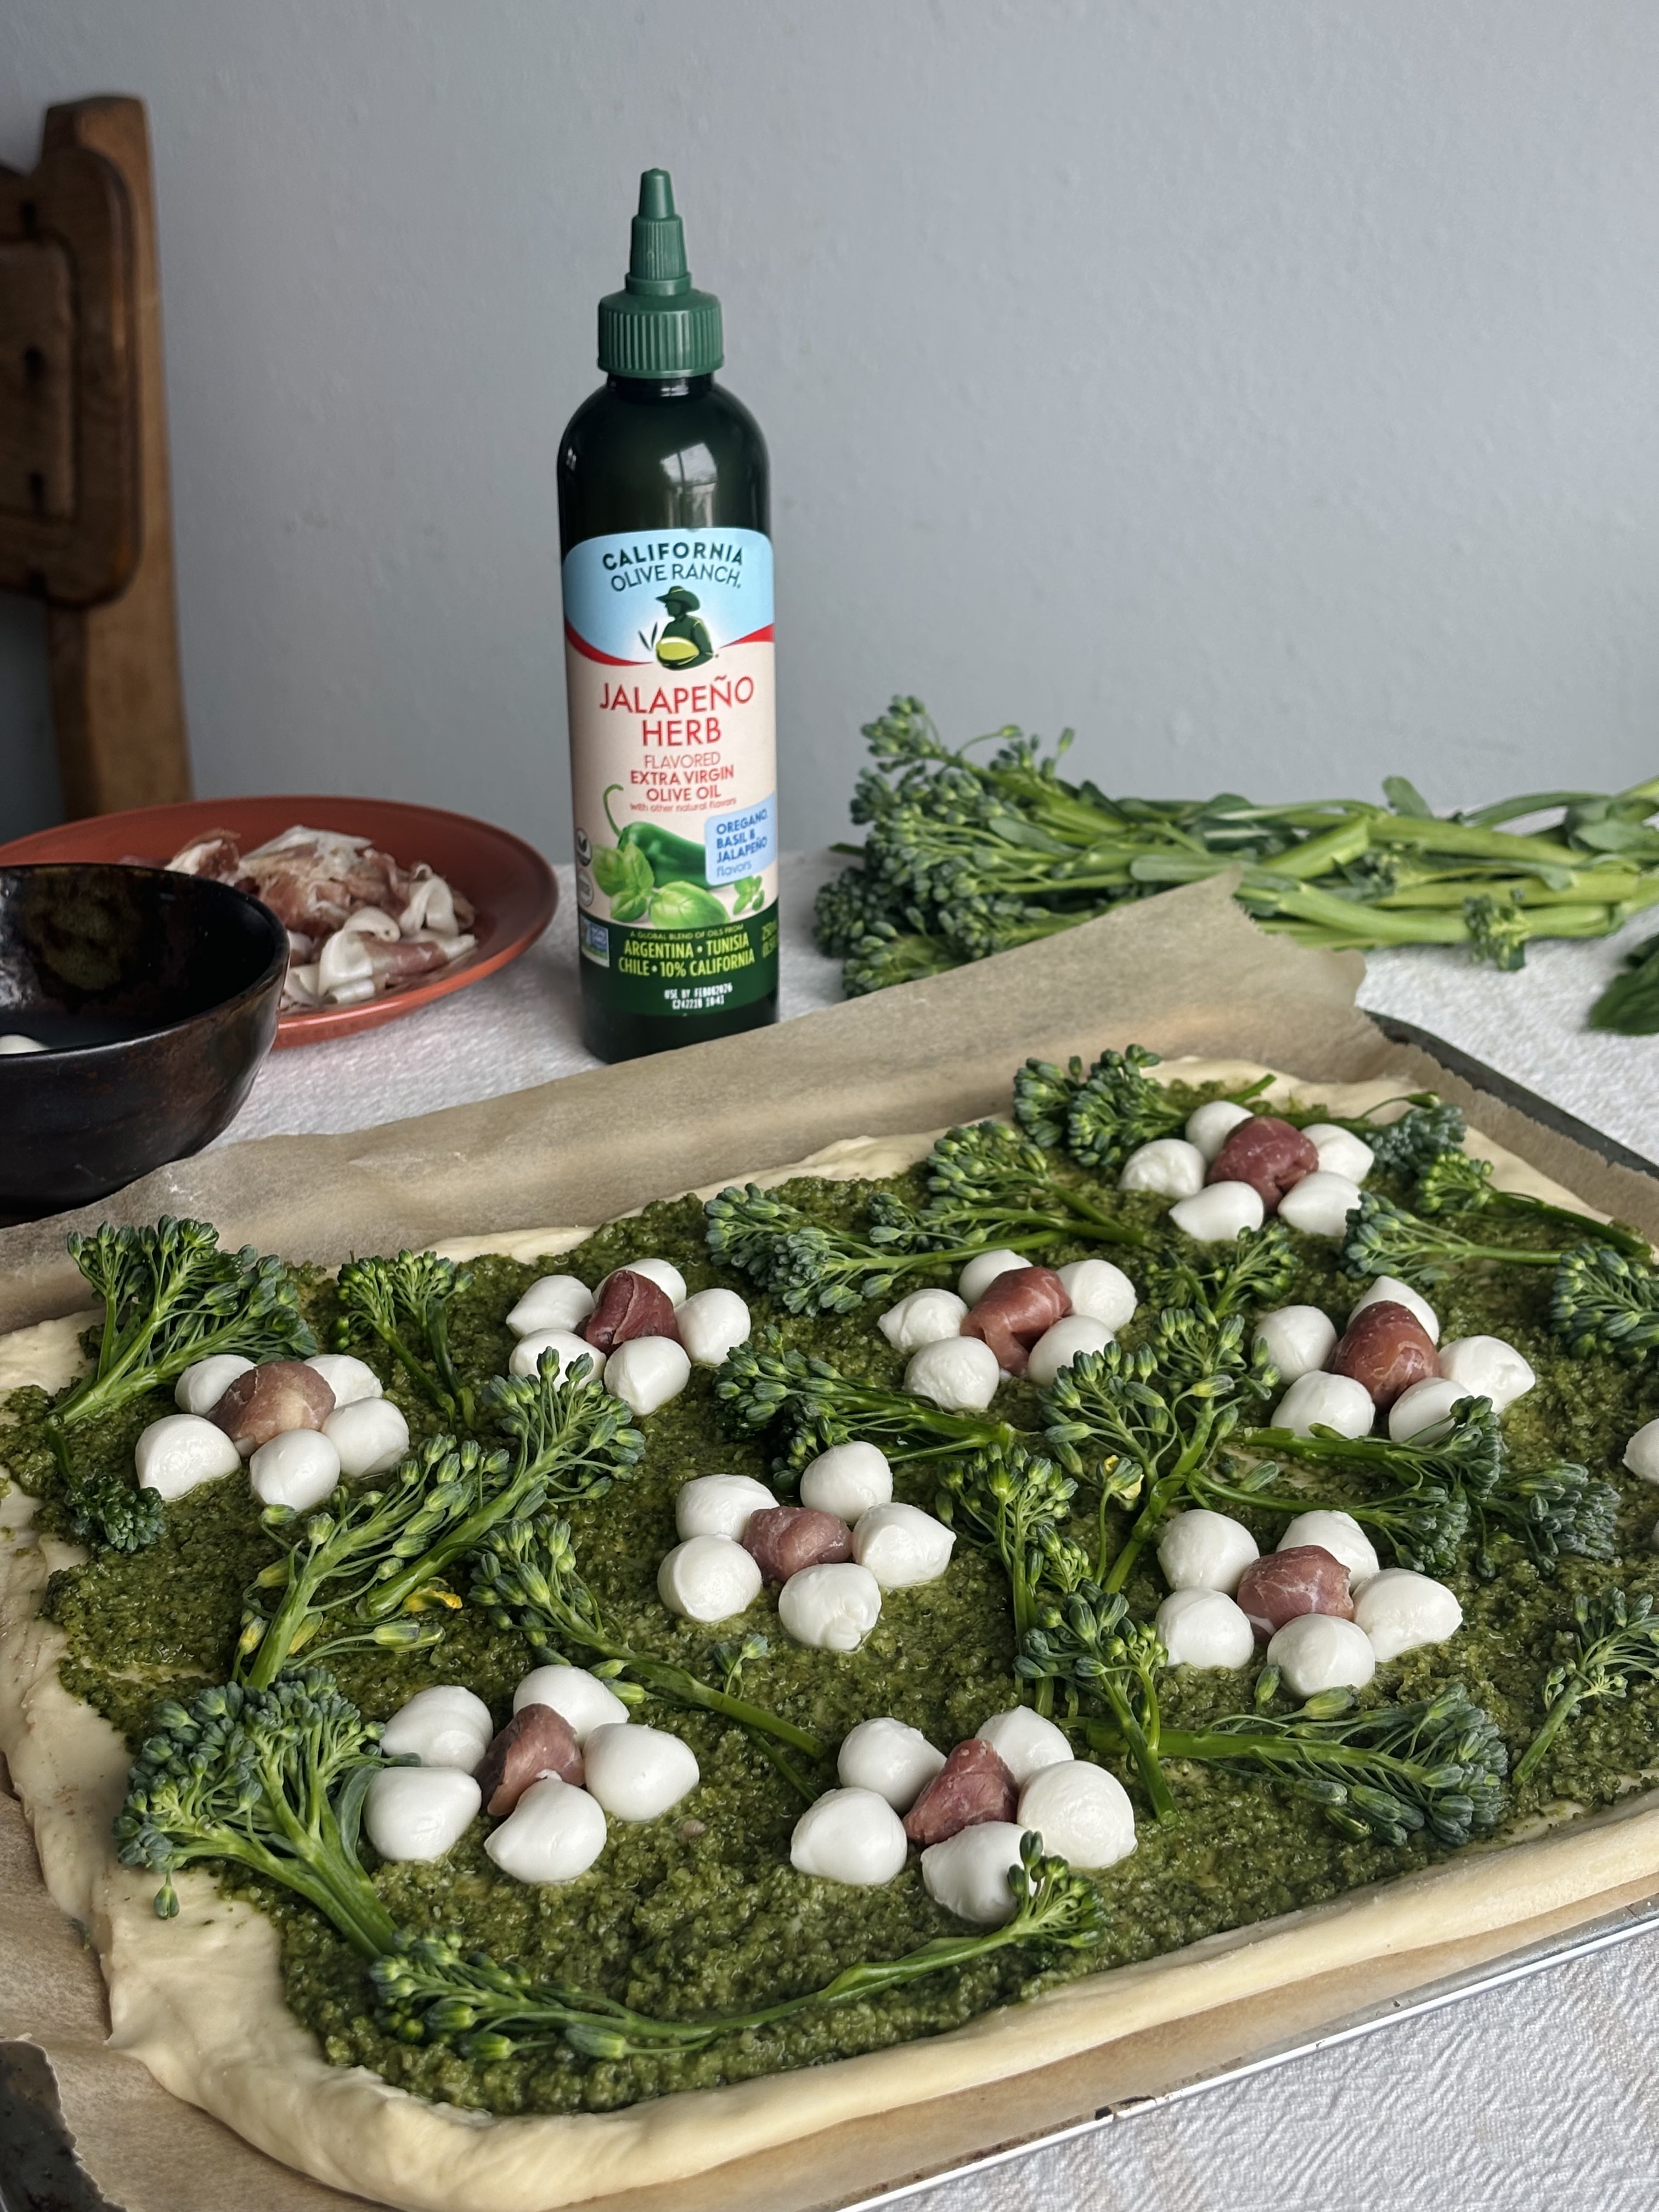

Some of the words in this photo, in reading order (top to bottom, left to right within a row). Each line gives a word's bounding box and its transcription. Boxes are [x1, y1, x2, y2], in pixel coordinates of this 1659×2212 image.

[602, 542, 742, 571] CALIFORNIA
[611, 565, 668, 592] OLIVE
[600, 675, 754, 714] JALAPEÑO
[642, 717, 721, 747] HERB
[644, 752, 721, 769] FLAVORED
[630, 770, 681, 785] EXTRA
[683, 765, 734, 784] VIRGIN
[646, 788, 692, 802] OLIVE
[697, 785, 721, 799] OIL
[651, 804, 673, 812] other
[676, 803, 707, 812] natural
[709, 798, 737, 809] flavors
[716, 832, 747, 849] BASIL
[716, 836, 767, 864] JALAPEÑO
[716, 861, 752, 877] flavors
[638, 932, 667, 940] GLOBAL
[669, 932, 693, 940] BLEND
[724, 924, 744, 934] FROM
[624, 939, 694, 959] ARGENTINA
[706, 933, 749, 956] TUNISIA
[618, 957, 650, 977] CHILE
[660, 961, 687, 978] 10%
[689, 948, 755, 977] CALIFORNIA
[664, 989, 678, 1000] USE
[681, 989, 691, 999] BY
